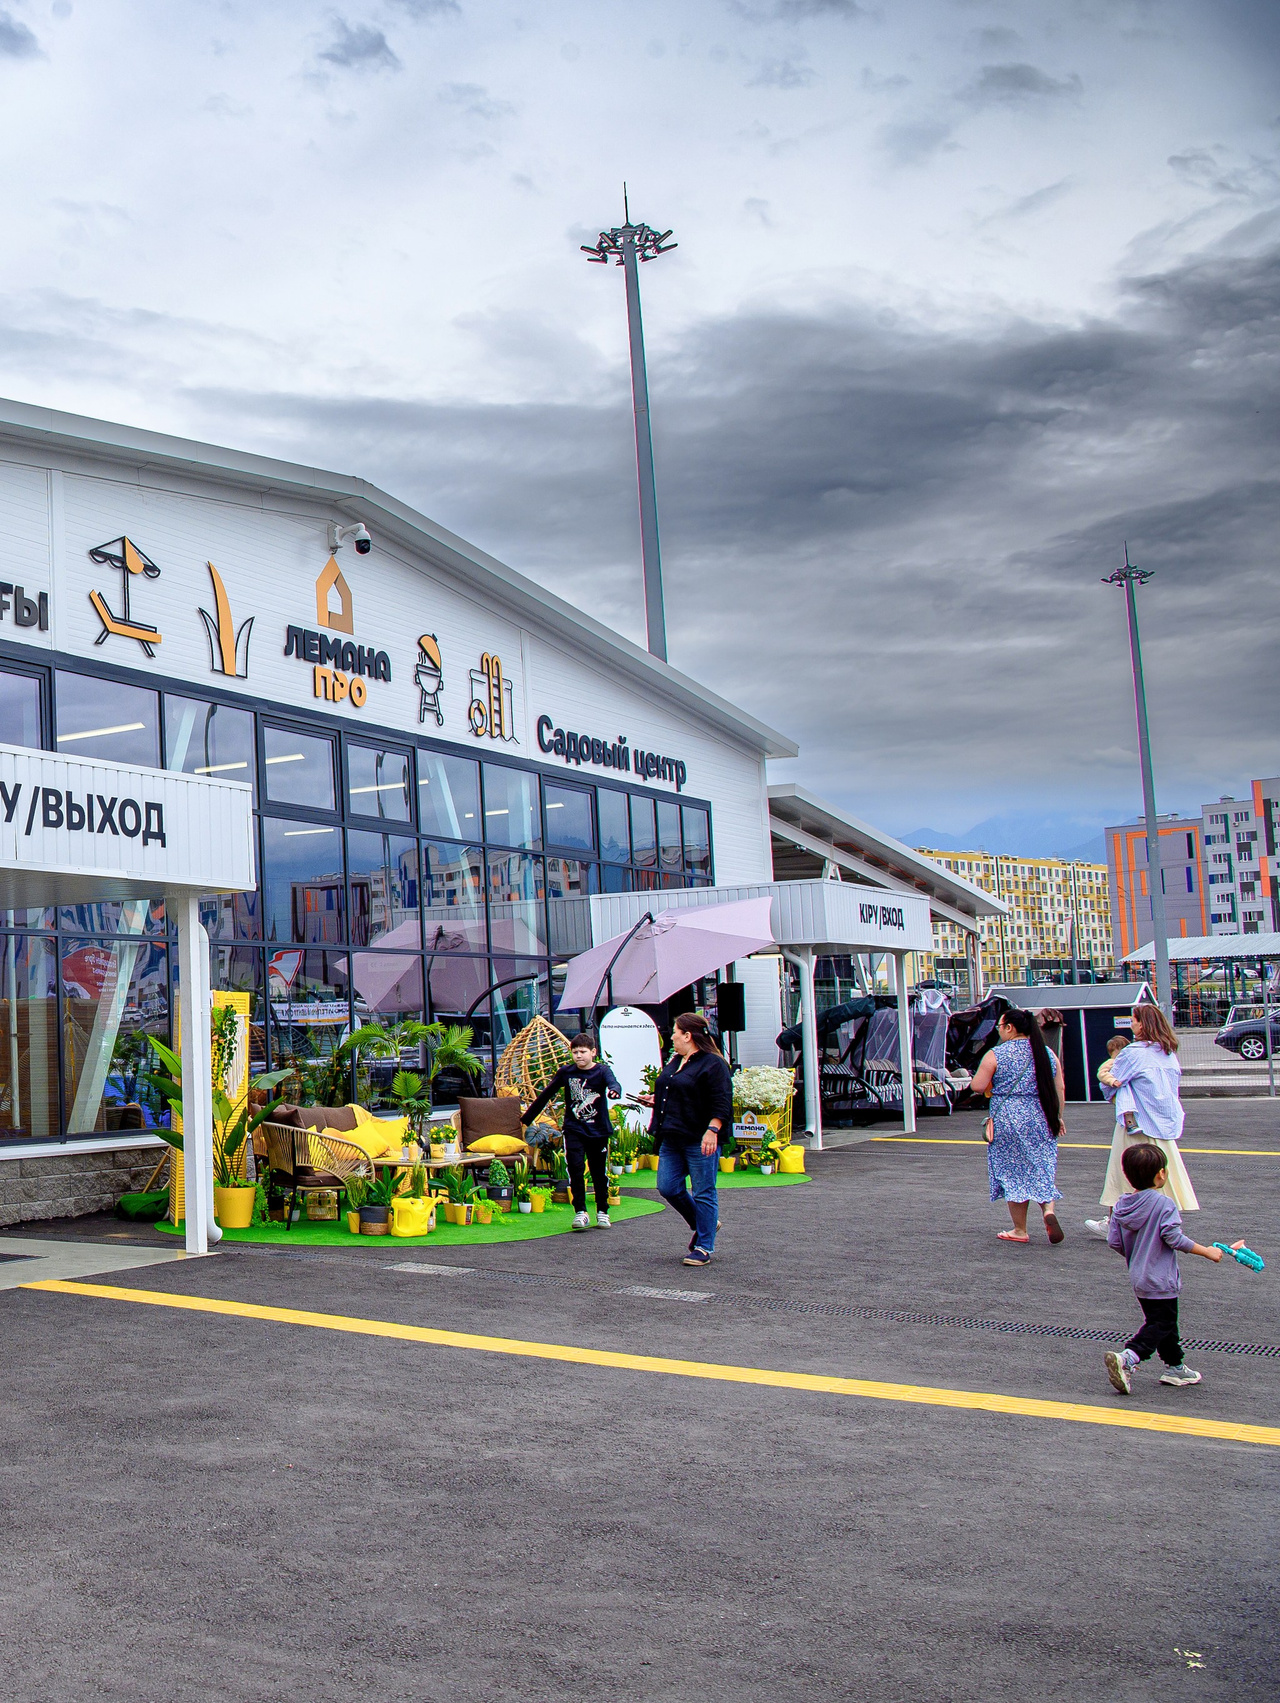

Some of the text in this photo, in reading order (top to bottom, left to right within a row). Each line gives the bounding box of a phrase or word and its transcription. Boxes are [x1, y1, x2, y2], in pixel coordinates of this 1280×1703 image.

[284, 624, 392, 682] ЛЕМАНА
[313, 665, 367, 707] ПРО
[537, 714, 687, 792] Садовый центр
